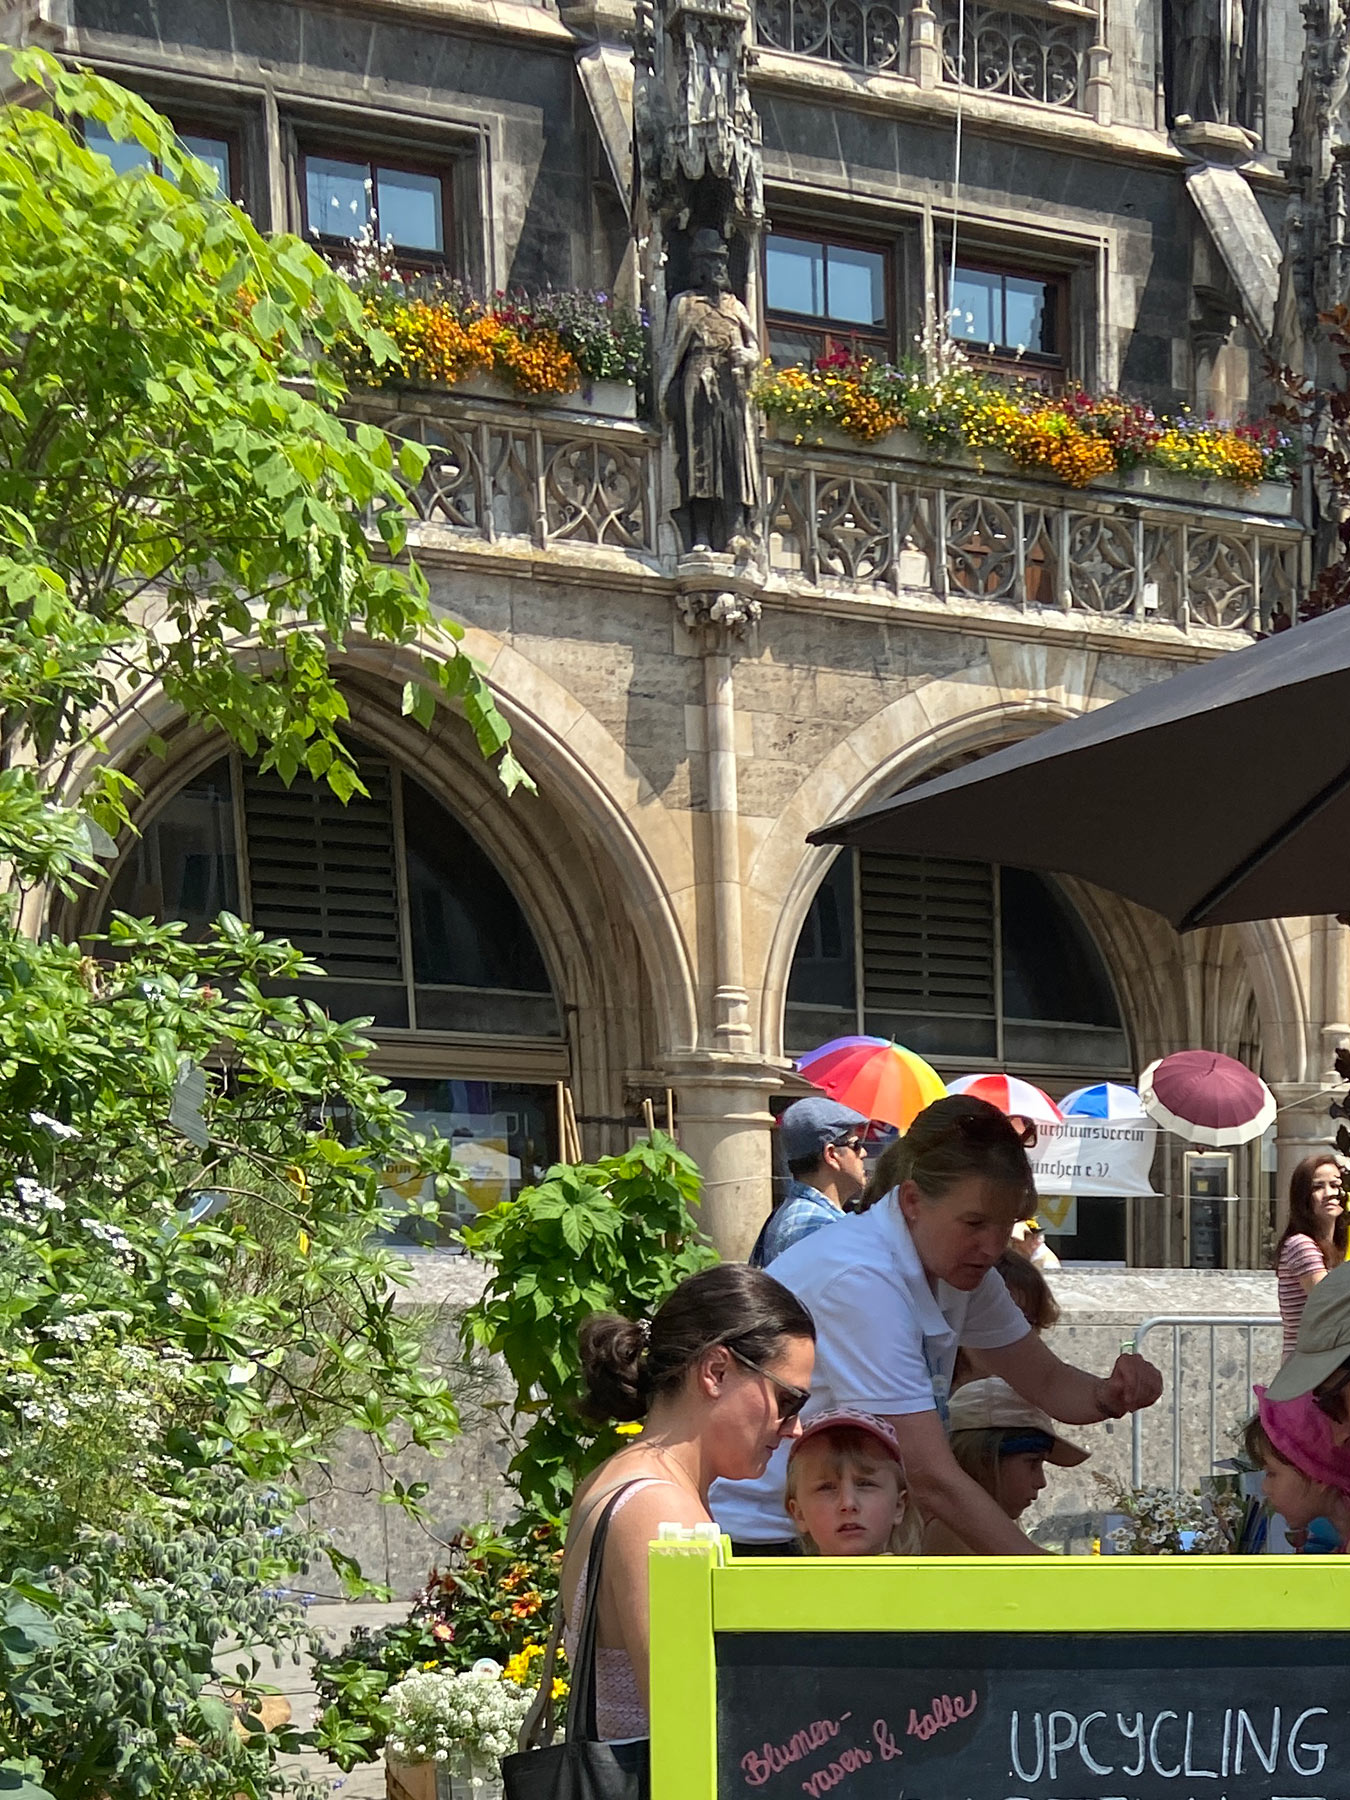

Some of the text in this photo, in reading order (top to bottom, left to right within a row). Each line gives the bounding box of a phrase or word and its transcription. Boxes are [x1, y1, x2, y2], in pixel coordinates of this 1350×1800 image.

[1036, 1122, 1145, 1142] uchtumsverein
[1030, 1160, 1082, 1179] ünchen
[872, 1718, 904, 1762] &
[1010, 1706, 1329, 1779] UPCYCLING
